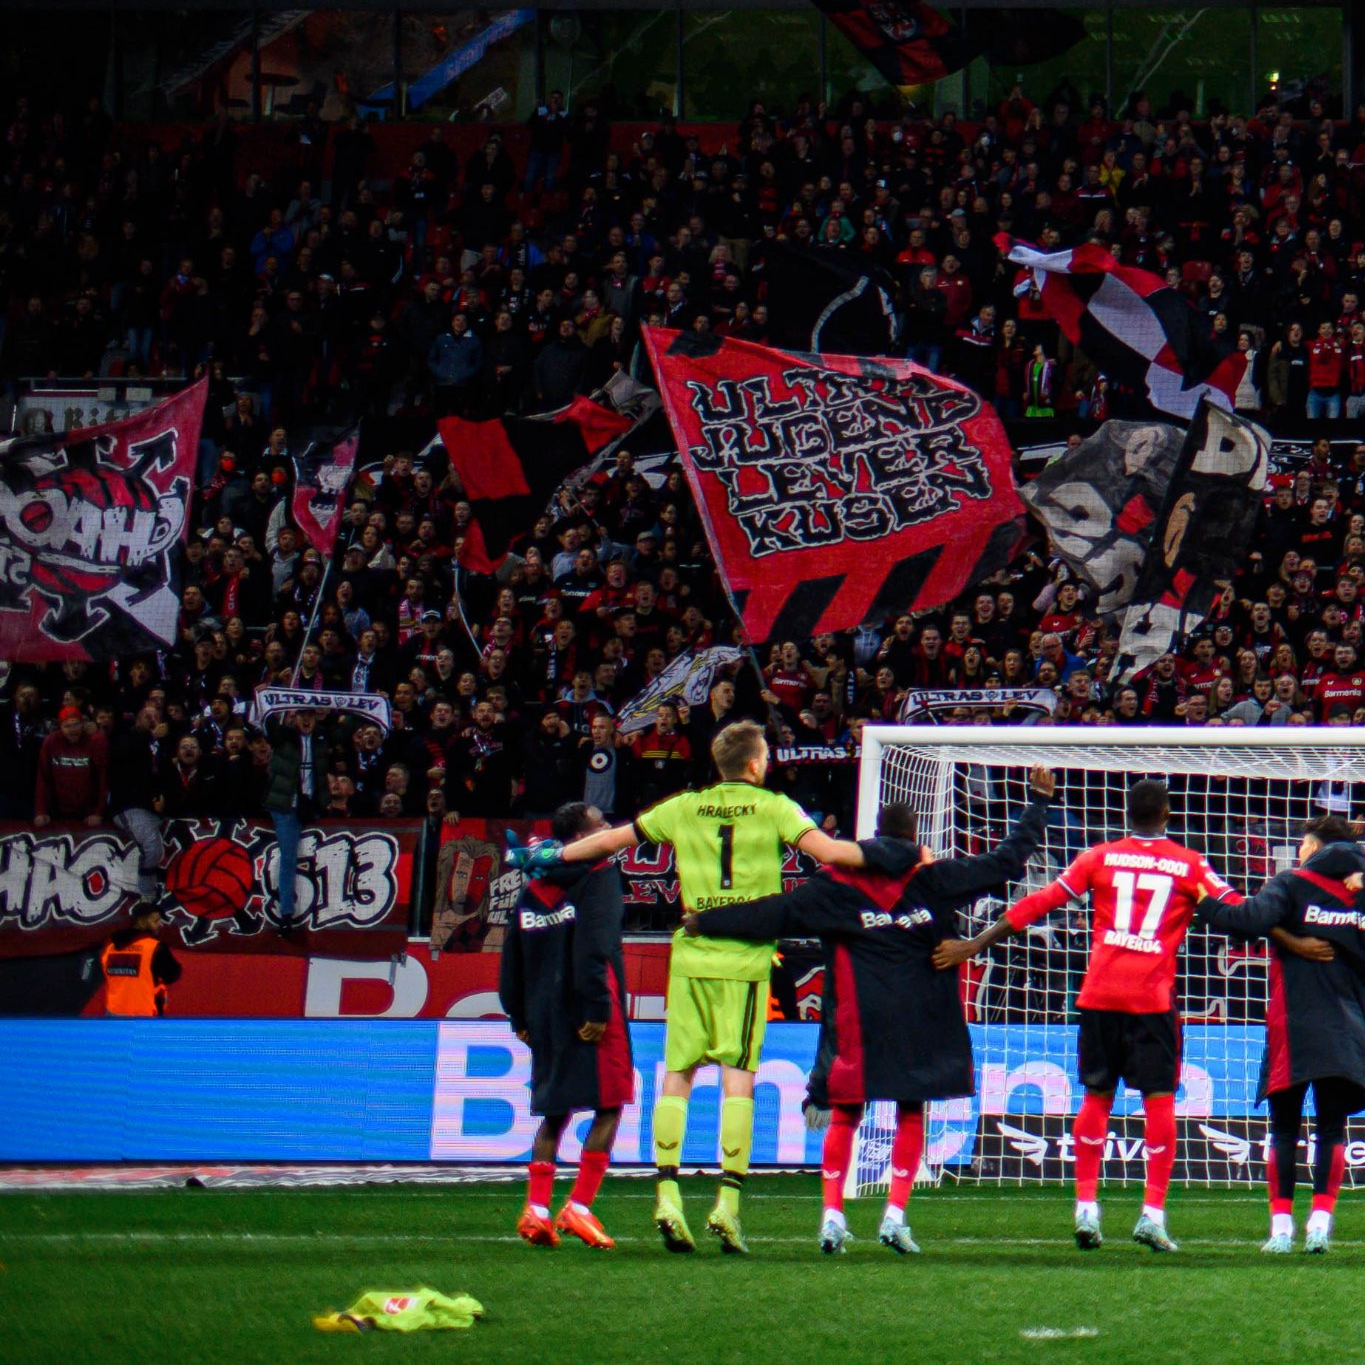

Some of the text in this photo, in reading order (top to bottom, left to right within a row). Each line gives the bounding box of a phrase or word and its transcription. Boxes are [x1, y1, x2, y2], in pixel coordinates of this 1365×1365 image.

[776, 746, 848, 763] ULTRAS
[718, 824, 735, 890] 1
[1104, 853, 1188, 877] HUDSON-ODOI
[1112, 871, 1174, 940] 17
[1104, 932, 1162, 954] BAYER04
